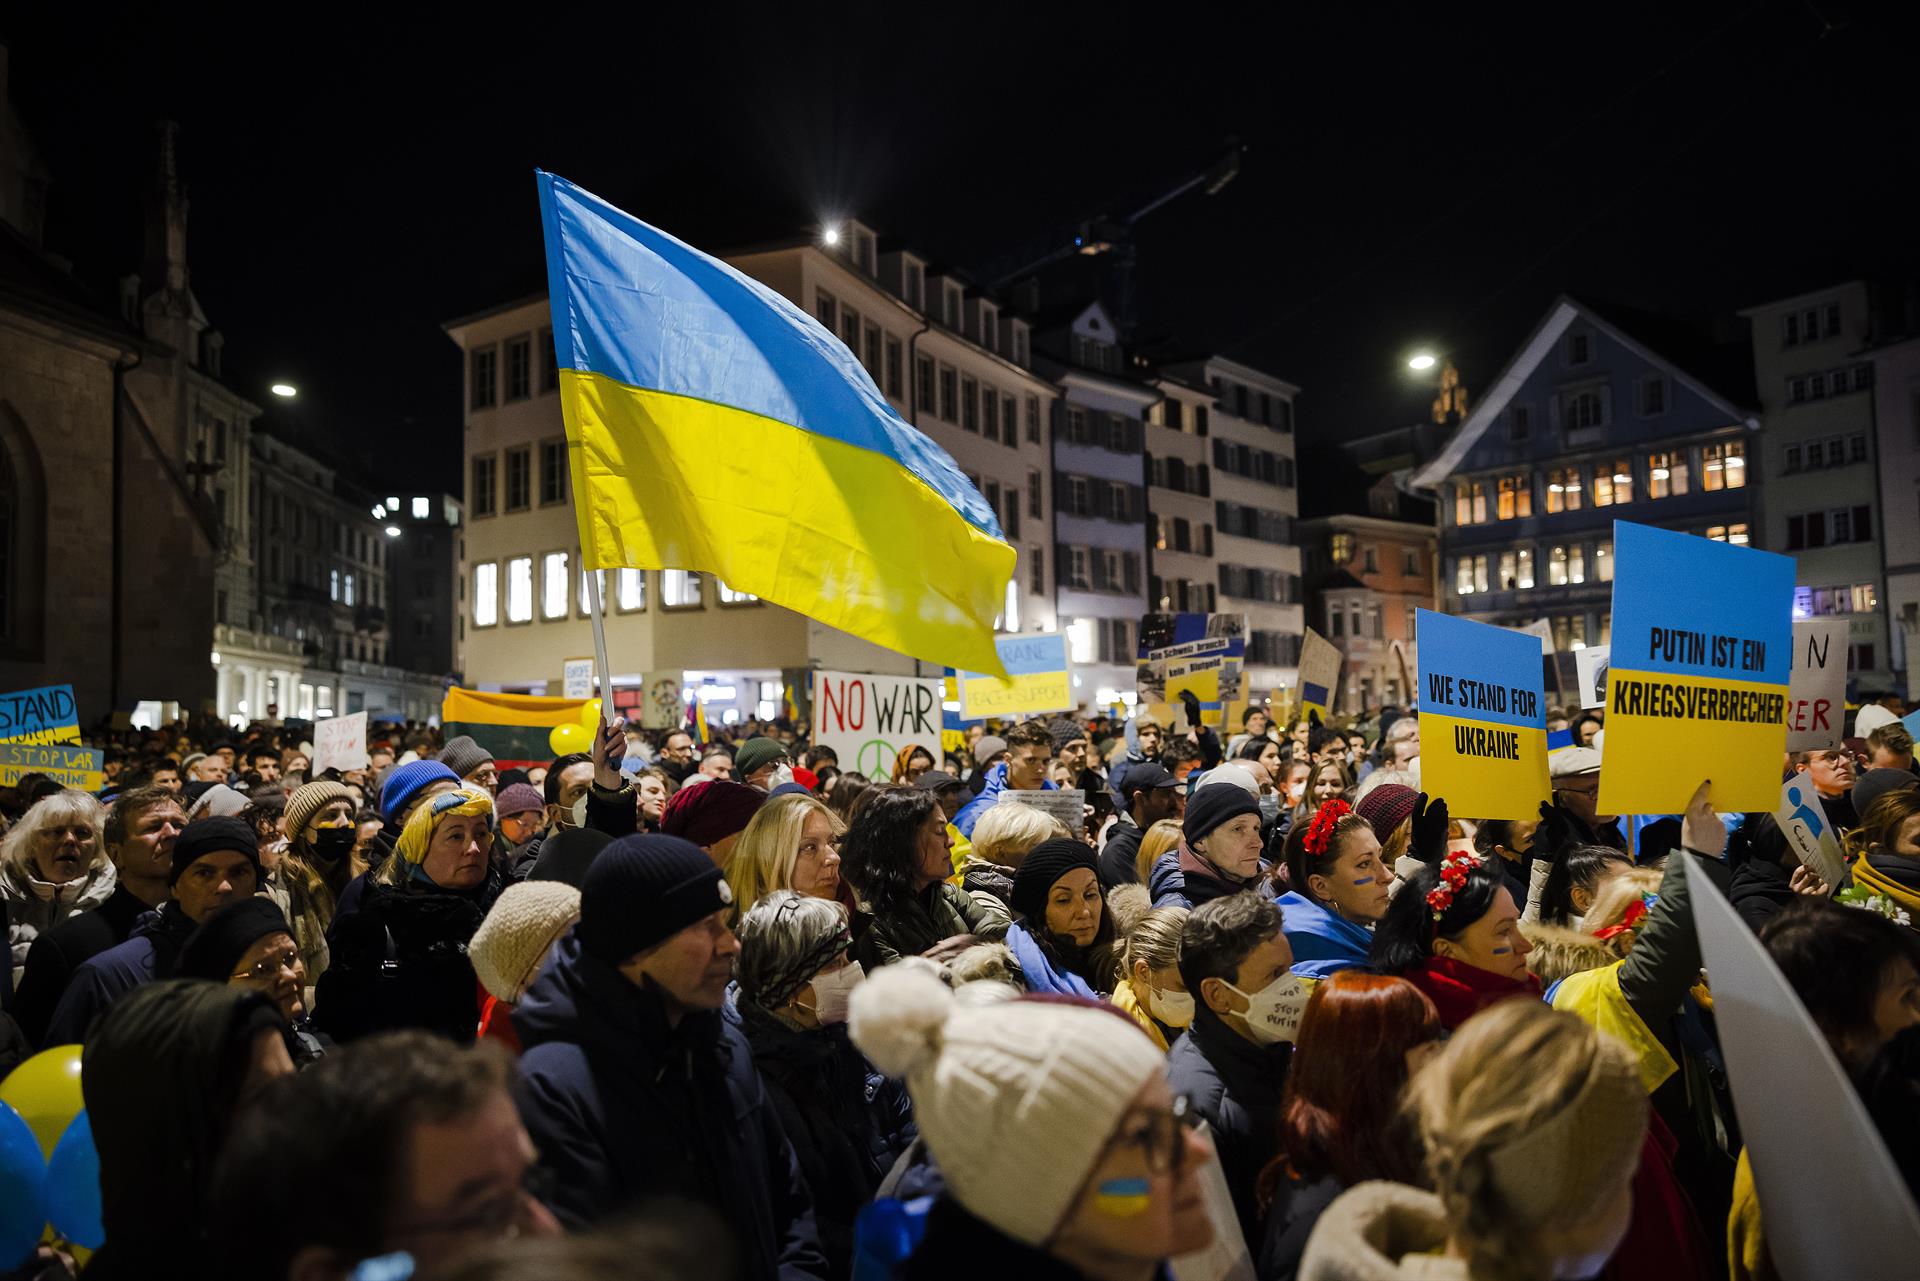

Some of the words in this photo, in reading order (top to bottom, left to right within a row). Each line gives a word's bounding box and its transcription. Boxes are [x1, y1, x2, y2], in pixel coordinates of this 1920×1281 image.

[998, 642, 1048, 664] RAINE
[1650, 627, 1705, 666] PUTIN
[1711, 635, 1738, 668] IST
[1742, 639, 1766, 672] EIN
[822, 677, 864, 733] NO
[871, 682, 934, 735] WAR
[1428, 673, 1454, 705] WE
[1458, 679, 1507, 713] STAND
[1510, 688, 1537, 718] FOR
[1613, 680, 1784, 724] KRIEGSVERBRECHER
[11, 748, 60, 766] STOP
[1455, 725, 1519, 760] UKRAINE
[1274, 1003, 1300, 1015] STOP
